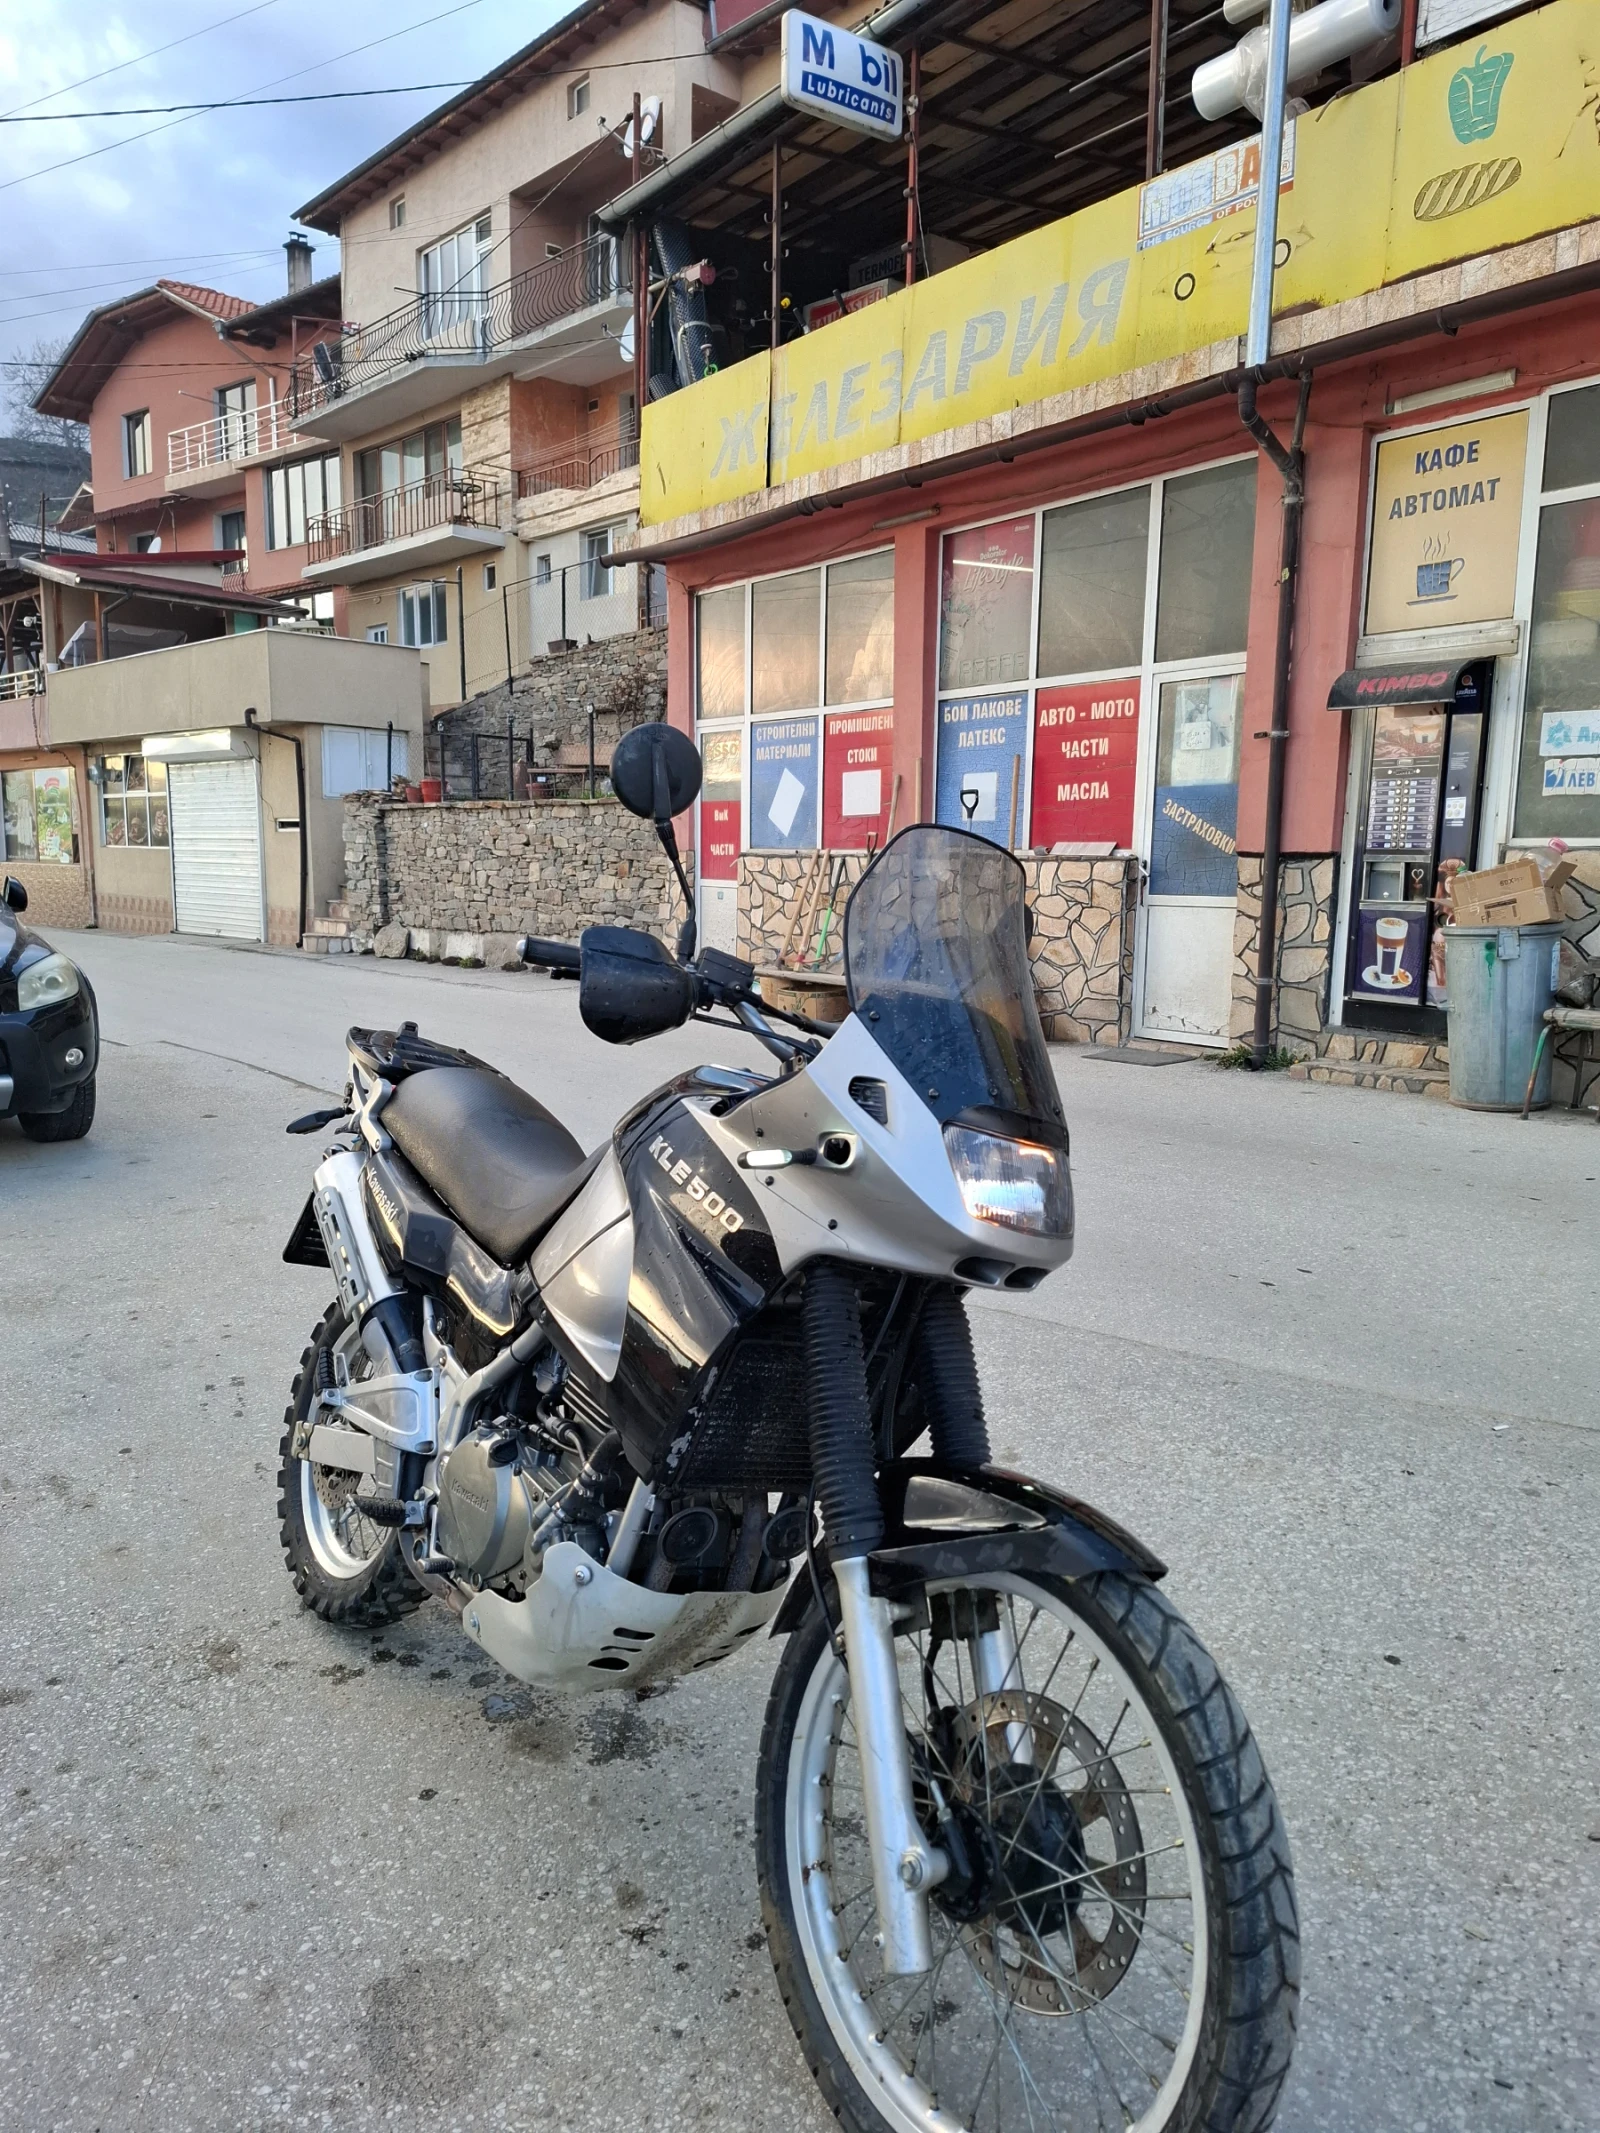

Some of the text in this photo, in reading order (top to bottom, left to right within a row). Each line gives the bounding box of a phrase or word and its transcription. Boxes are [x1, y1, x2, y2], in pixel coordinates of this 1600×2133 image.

[807, 73, 893, 120] Lubricants
[1142, 233, 1162, 249] THE
[1165, 216, 1212, 241] SOURCE
[1216, 206, 1232, 219] OF
[710, 258, 1130, 478] ЖЕЛЕЗАРИЯ
[1415, 440, 1480, 474] КАФЕ
[1389, 477, 1501, 520] АВТОМАТ
[1356, 671, 1449, 694] KIMBO
[943, 699, 1022, 723] БОИ ЛАКОВЕ
[1039, 706, 1075, 727] АВТО
[1091, 698, 1134, 720] МОТО
[756, 722, 815, 741] СТРОИТЕЛКИ
[958, 727, 1006, 748] ЛАТЕКС
[1577, 726, 1600, 744] Ар
[756, 743, 811, 761] МАТЕРИАЛИ
[847, 747, 878, 764] СТОКИ
[1061, 738, 1109, 758] ЧАСТИ
[1057, 781, 1109, 801] МАСЛА
[1567, 772, 1596, 788] ЛЕВ
[1163, 799, 1236, 855] ЗАСТРАХОВКИ
[710, 843, 734, 856] ЧАСТИ
[366, 1167, 399, 1222] Kawasaki
[451, 1478, 489, 1513] Kawasaki
